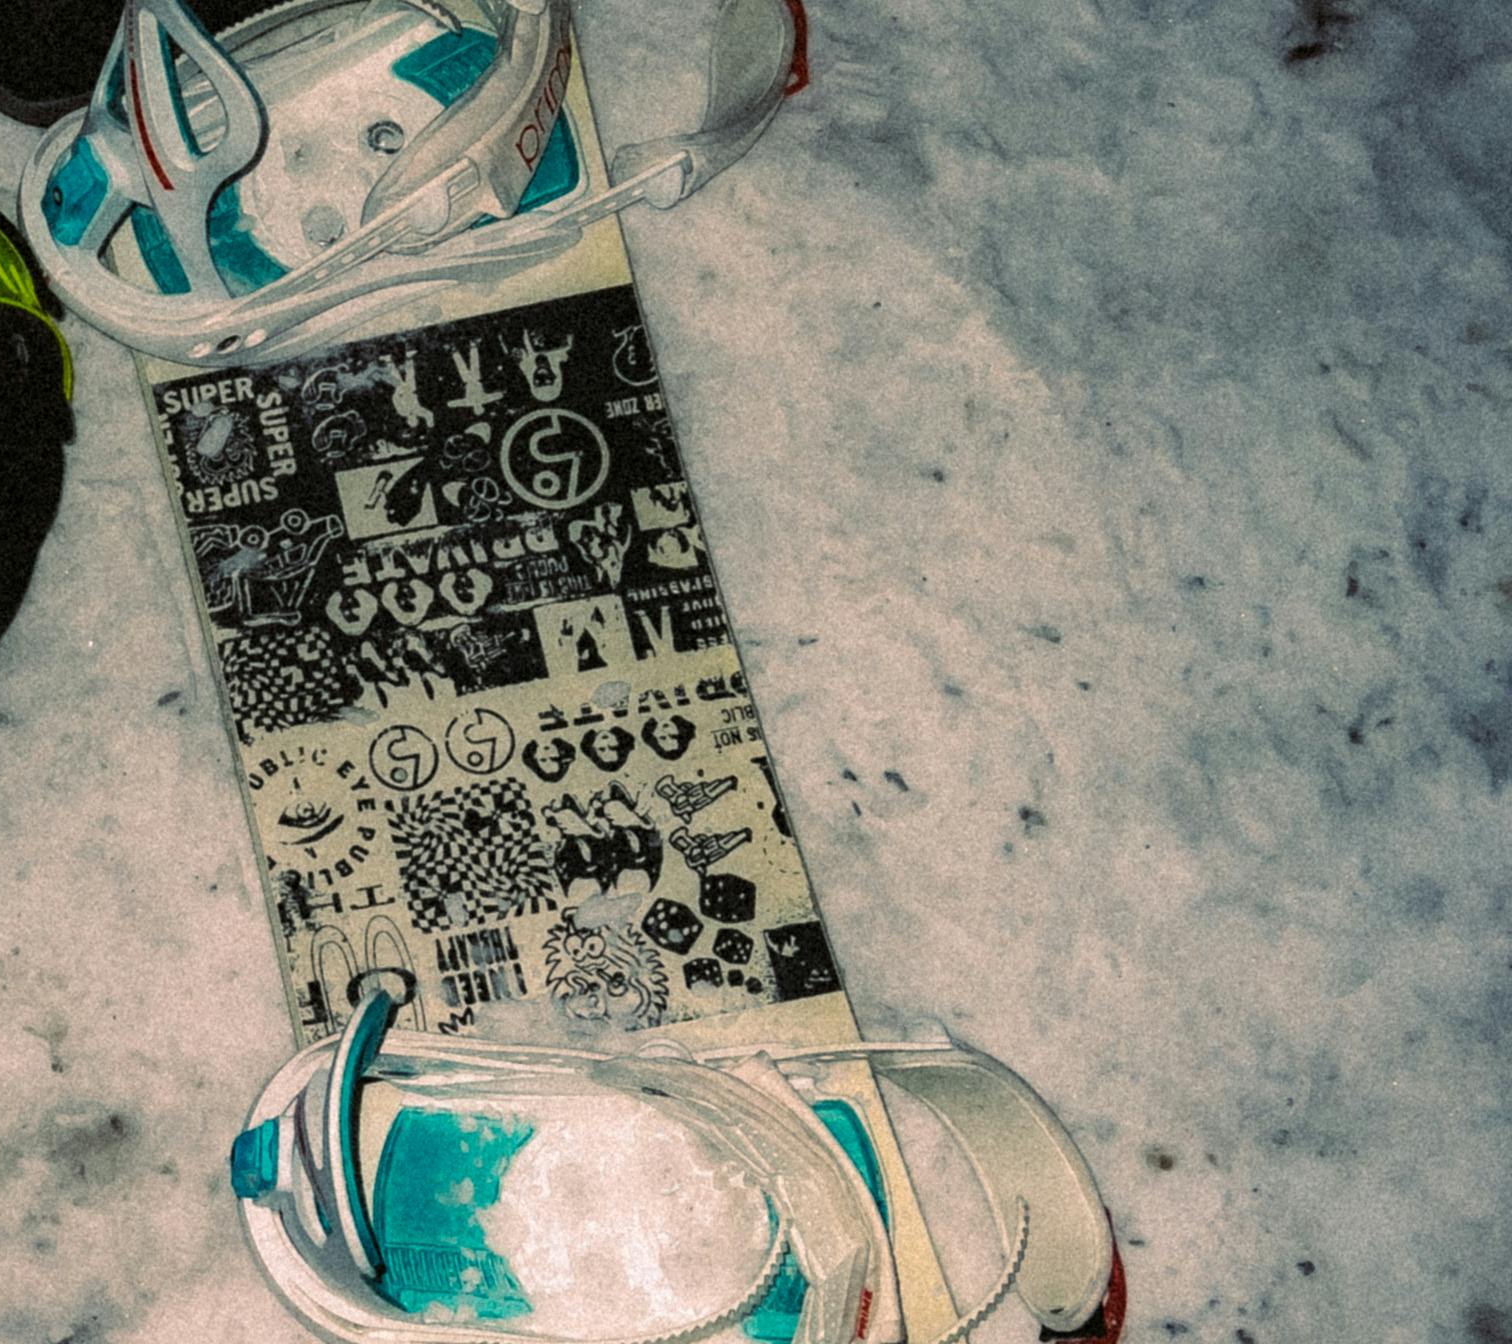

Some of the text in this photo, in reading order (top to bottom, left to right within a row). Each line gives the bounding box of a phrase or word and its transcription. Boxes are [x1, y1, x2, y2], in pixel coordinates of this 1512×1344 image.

[162, 377, 256, 414] SUPER
[604, 396, 641, 419] ZONE
[255, 392, 299, 478] SUPER
[186, 475, 280, 514] SUPER
[711, 726, 742, 754] NOT
[337, 759, 376, 813] EYE
